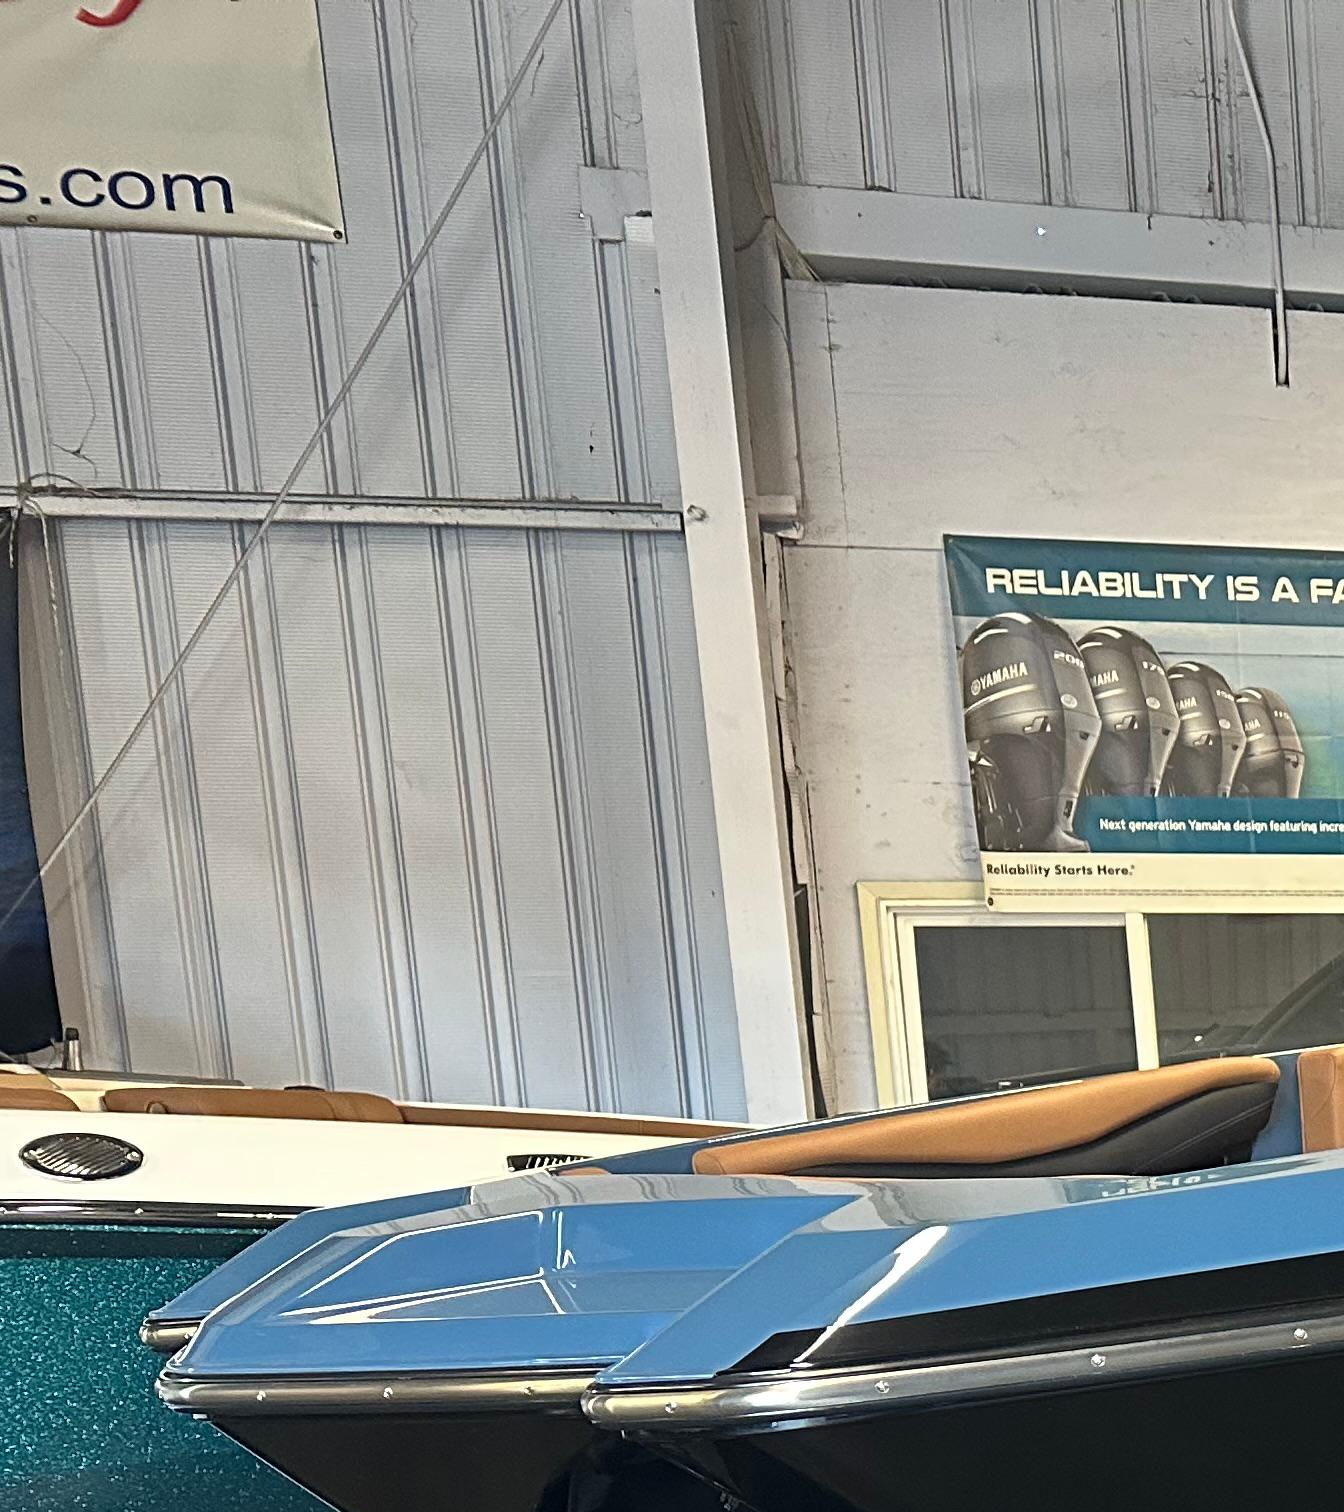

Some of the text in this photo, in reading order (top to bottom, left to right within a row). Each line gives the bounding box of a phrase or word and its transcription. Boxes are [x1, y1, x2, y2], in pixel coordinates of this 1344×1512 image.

[985, 567, 1215, 600] RELIABILITY
[1226, 575, 1259, 602] IS
[1271, 576, 1300, 604] A
[980, 661, 1029, 690] YAMAHA
[1099, 818, 1126, 830] Next
[1128, 819, 1187, 833] generation
[1188, 820, 1232, 831] Yamaha
[1233, 820, 1268, 834] design
[1269, 820, 1318, 834] featuring
[986, 863, 1051, 878] Reliability
[1054, 864, 1093, 876] Starts
